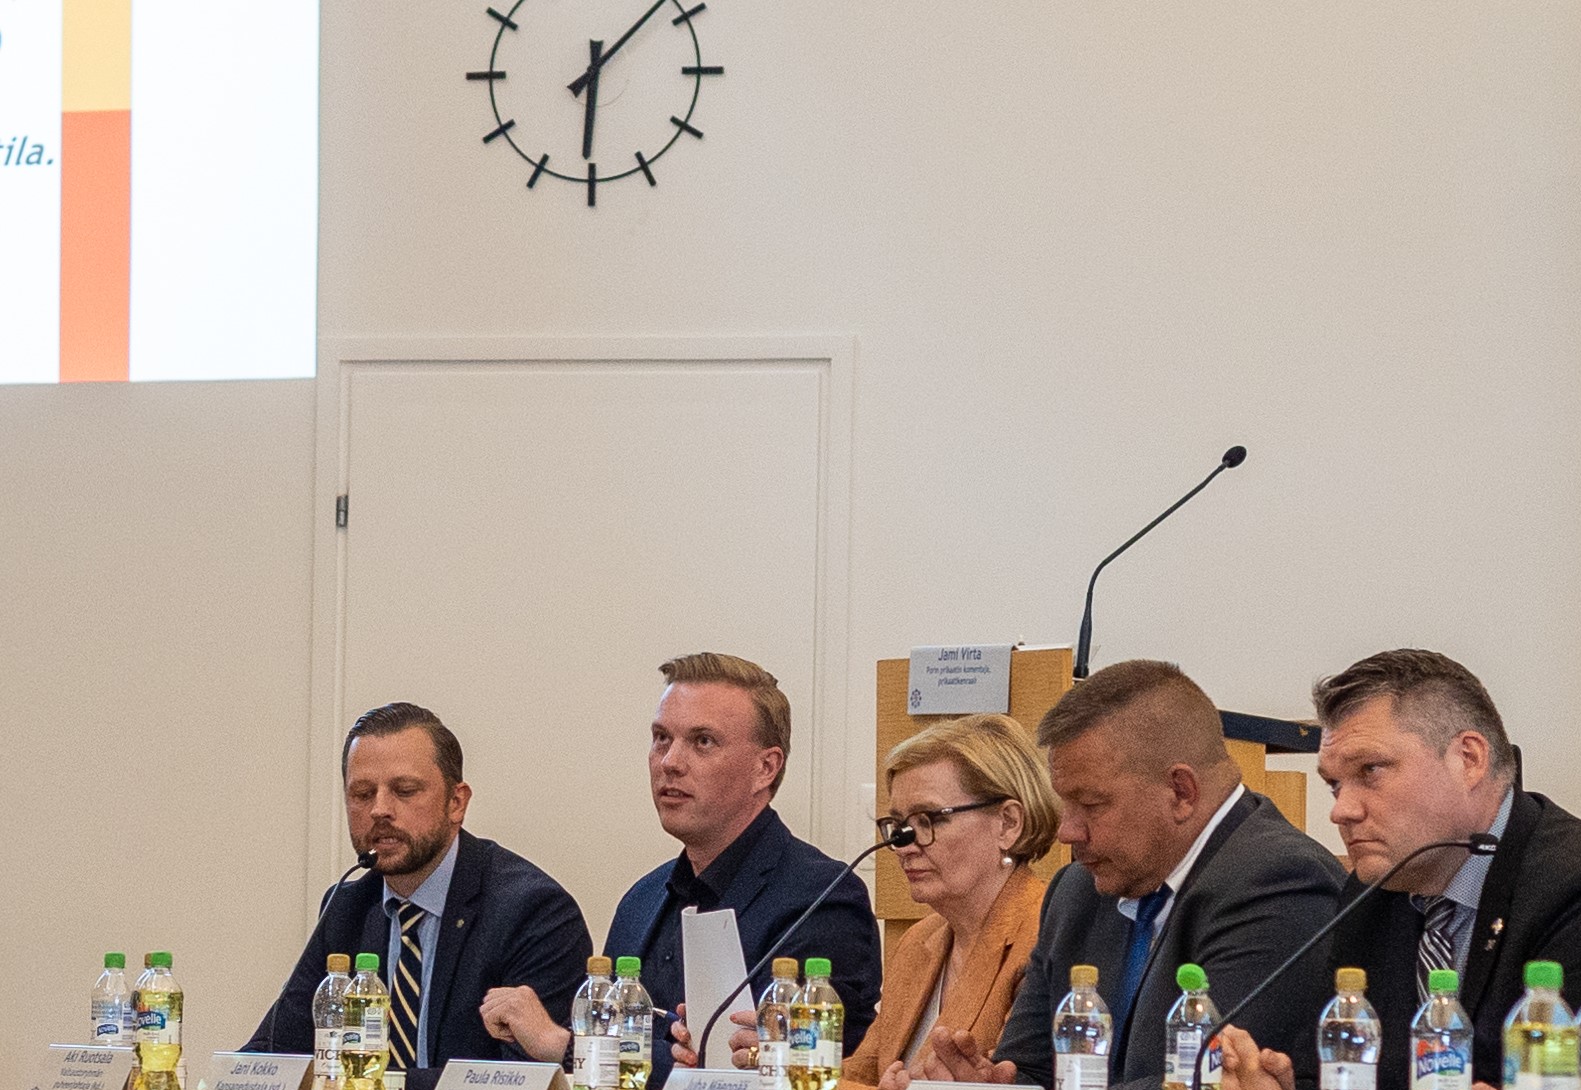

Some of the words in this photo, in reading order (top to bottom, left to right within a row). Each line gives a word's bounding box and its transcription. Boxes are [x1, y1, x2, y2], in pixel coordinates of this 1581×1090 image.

[0, 135, 54, 166] ila.
[938, 648, 959, 661] Jami
[961, 647, 982, 660] Virta
[64, 1050, 79, 1063] Aki
[79, 1050, 114, 1064] Ruotsala
[1417, 1052, 1463, 1074] Novelle
[230, 1061, 251, 1075] Jani
[251, 1061, 279, 1076] Kokko
[463, 1069, 490, 1084] Paula
[490, 1070, 526, 1086] Risikko
